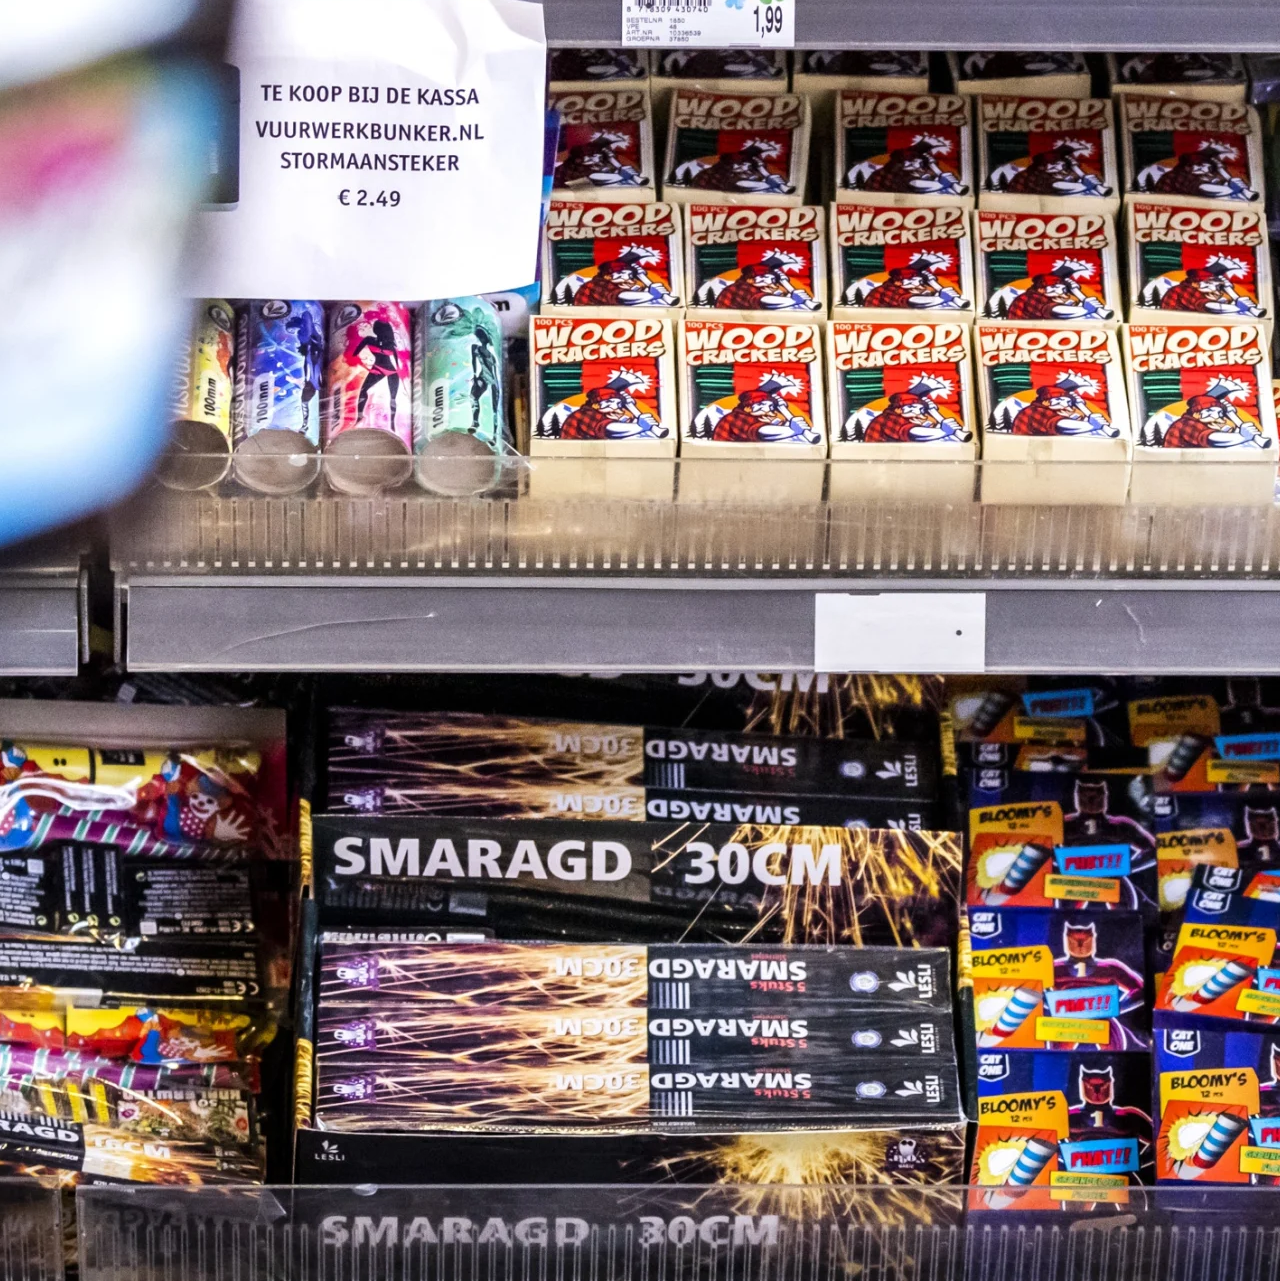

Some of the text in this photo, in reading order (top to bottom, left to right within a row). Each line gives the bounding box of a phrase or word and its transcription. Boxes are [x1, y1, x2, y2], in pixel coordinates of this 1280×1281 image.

[753, 6, 783, 38] 1,99
[261, 85, 479, 106] TE KOOP BIJ DE KASSA
[256, 121, 484, 141] VUURWERKBUNKER.NL
[280, 151, 460, 171] STORMAANSTEKER
[338, 189, 401, 207] € 2.49
[691, 206, 816, 229] WOOD
[690, 225, 819, 244] CRACKERS
[535, 320, 662, 346] WOOD
[982, 327, 1109, 352] WOOD
[1130, 326, 1258, 353] WOOD
[534, 340, 665, 365] CRACKERS
[982, 345, 1111, 365] CRACKERS
[1130, 347, 1262, 369] CRACKERS
[433, 386, 446, 429] 100mm
[334, 837, 842, 887] SMARAGD 30CM
[555, 957, 808, 981] SMARAGD 30CM
[750, 980, 793, 991] Stuks
[919, 964, 933, 998] LESLI
[1169, 1041, 1195, 1052] ONE
[1171, 1030, 1194, 1041] CAT
[1170, 1072, 1247, 1090] BLOOMY'S
[980, 1096, 1057, 1114] BLOOMY'S
[320, 1216, 589, 1246] SMARAGD
